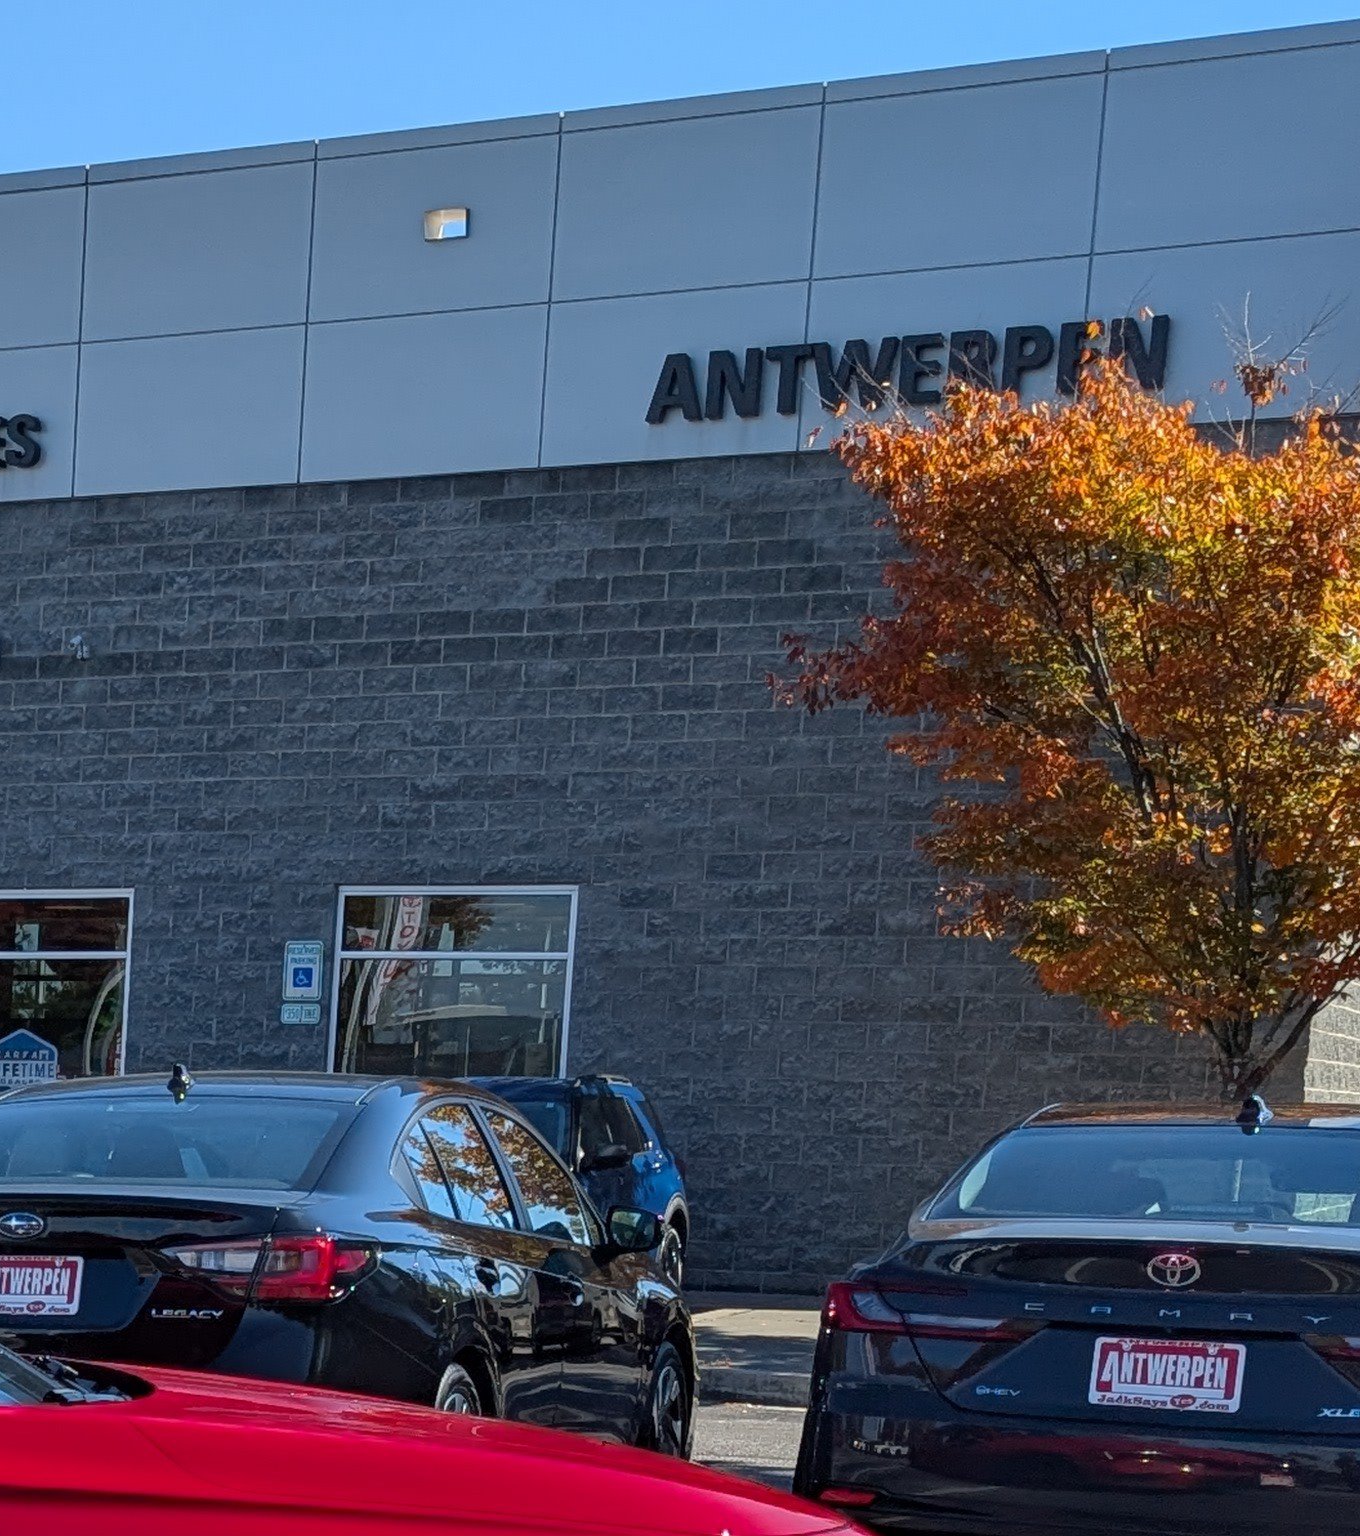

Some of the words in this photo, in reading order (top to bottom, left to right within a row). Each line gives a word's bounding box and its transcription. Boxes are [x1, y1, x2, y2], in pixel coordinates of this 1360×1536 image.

[644, 314, 1170, 424] ANTWERPEN
[151, 1308, 224, 1320] LEGACY
[1100, 1350, 1229, 1389] ANTWERPEN
